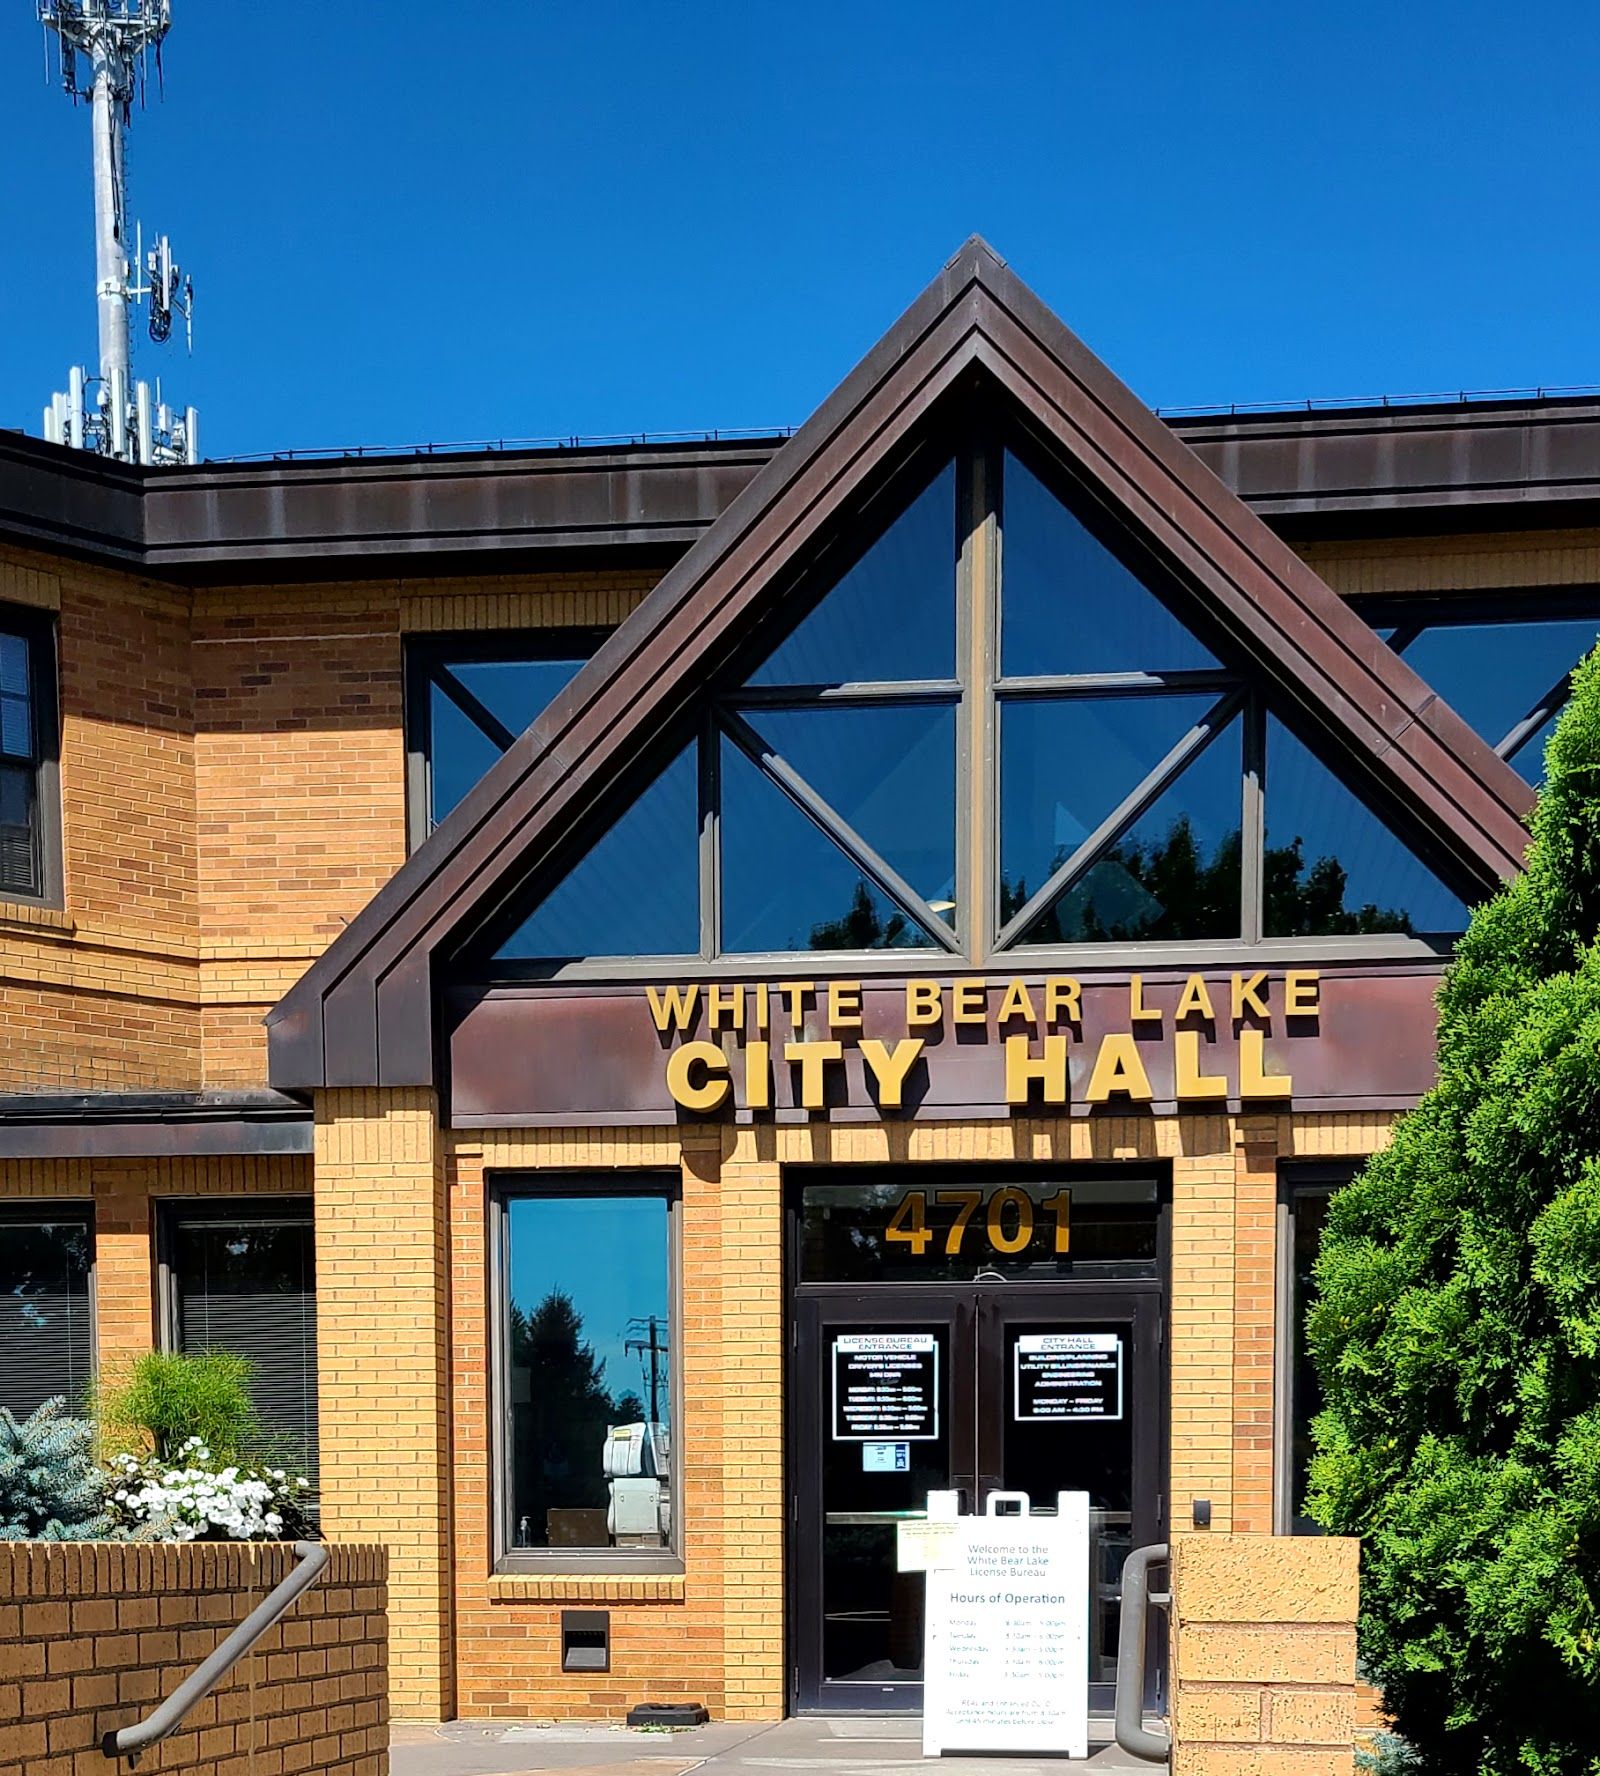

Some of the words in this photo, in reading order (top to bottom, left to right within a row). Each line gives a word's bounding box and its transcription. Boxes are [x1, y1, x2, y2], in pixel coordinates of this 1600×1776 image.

[646, 981, 863, 1031] WHITE
[907, 977, 1081, 1026] BEAR
[1130, 970, 1321, 1021] LAKE
[666, 1038, 925, 1113] CITY
[1005, 1030, 1293, 1105] HALL
[885, 1187, 1071, 1255] 4701
[968, 1544, 1016, 1554] Welcome
[1018, 1545, 1029, 1554] to
[1031, 1544, 1049, 1554] the
[967, 1556, 998, 1565] White
[1000, 1556, 1024, 1565] Bear
[1026, 1556, 1049, 1565] Lake
[970, 1567, 1007, 1577] License
[1010, 1567, 1046, 1577] Bureau
[950, 1592, 985, 1603] Hours
[989, 1592, 1001, 1603] of
[1004, 1593, 1065, 1605] Operation
